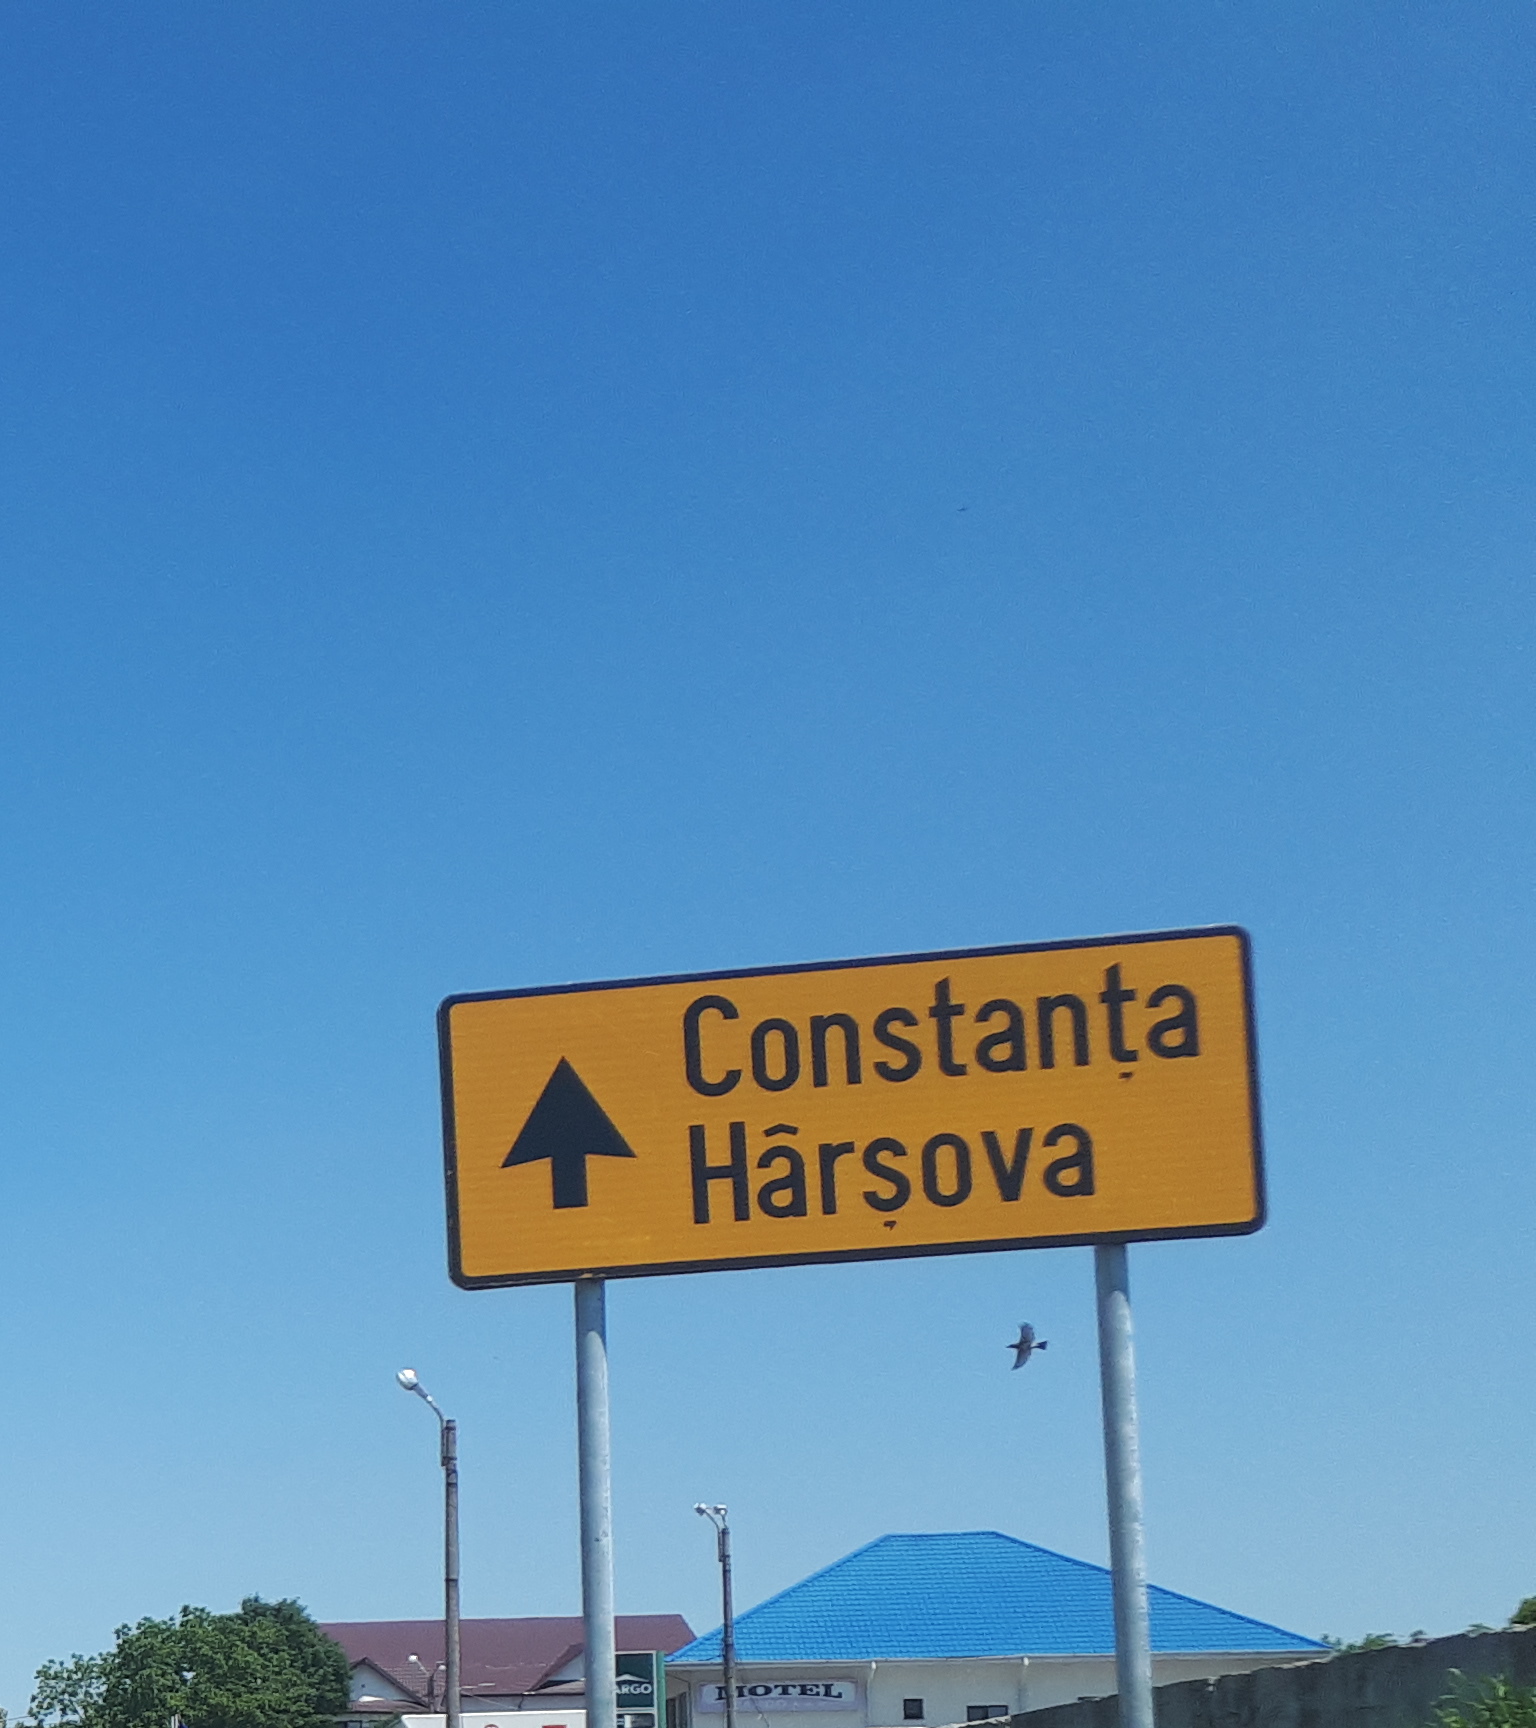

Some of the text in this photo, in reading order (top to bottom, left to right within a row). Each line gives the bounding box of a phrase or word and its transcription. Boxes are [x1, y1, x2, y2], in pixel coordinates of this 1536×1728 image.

[683, 962, 1201, 1098] Constanța
[688, 1121, 1096, 1230] Hârșova
[715, 1683, 843, 1700] MOTEL
